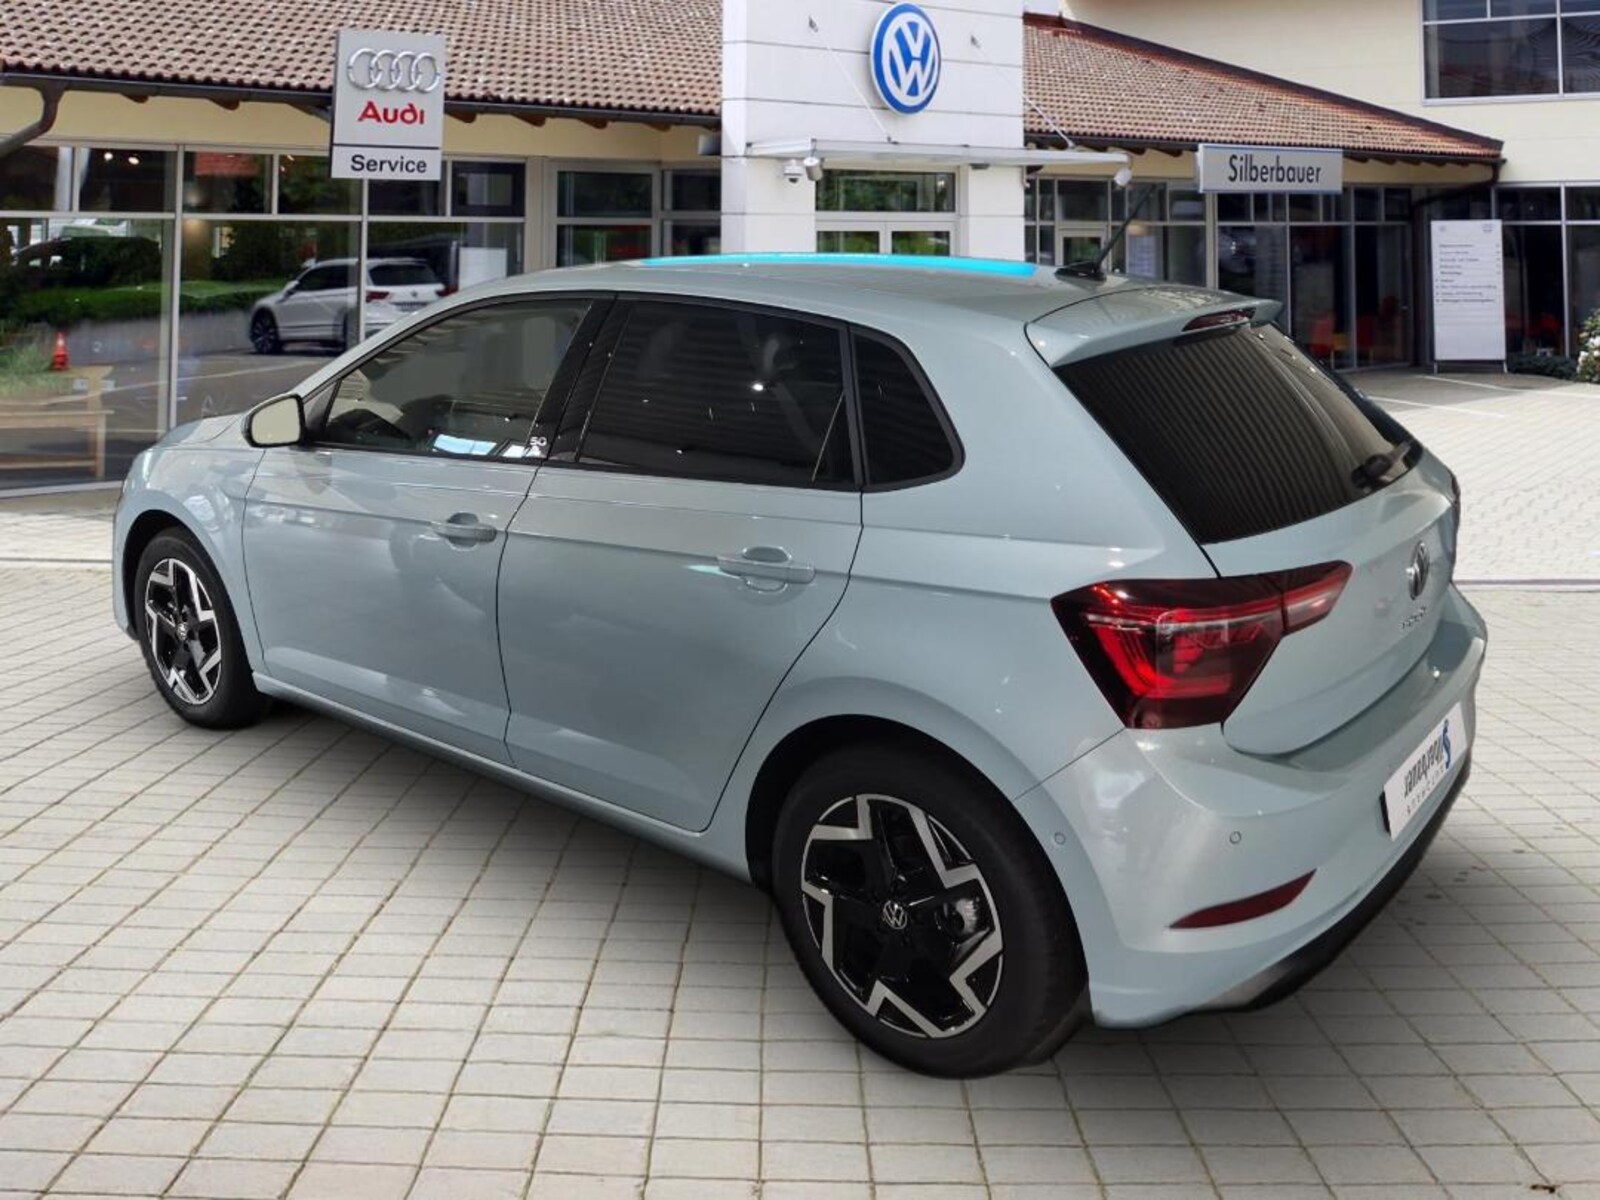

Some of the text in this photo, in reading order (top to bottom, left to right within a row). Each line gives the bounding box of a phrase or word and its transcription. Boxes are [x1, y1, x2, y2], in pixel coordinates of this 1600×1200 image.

[357, 100, 425, 125] Audi
[350, 154, 427, 173] Service
[1227, 153, 1321, 183] Silberbauer
